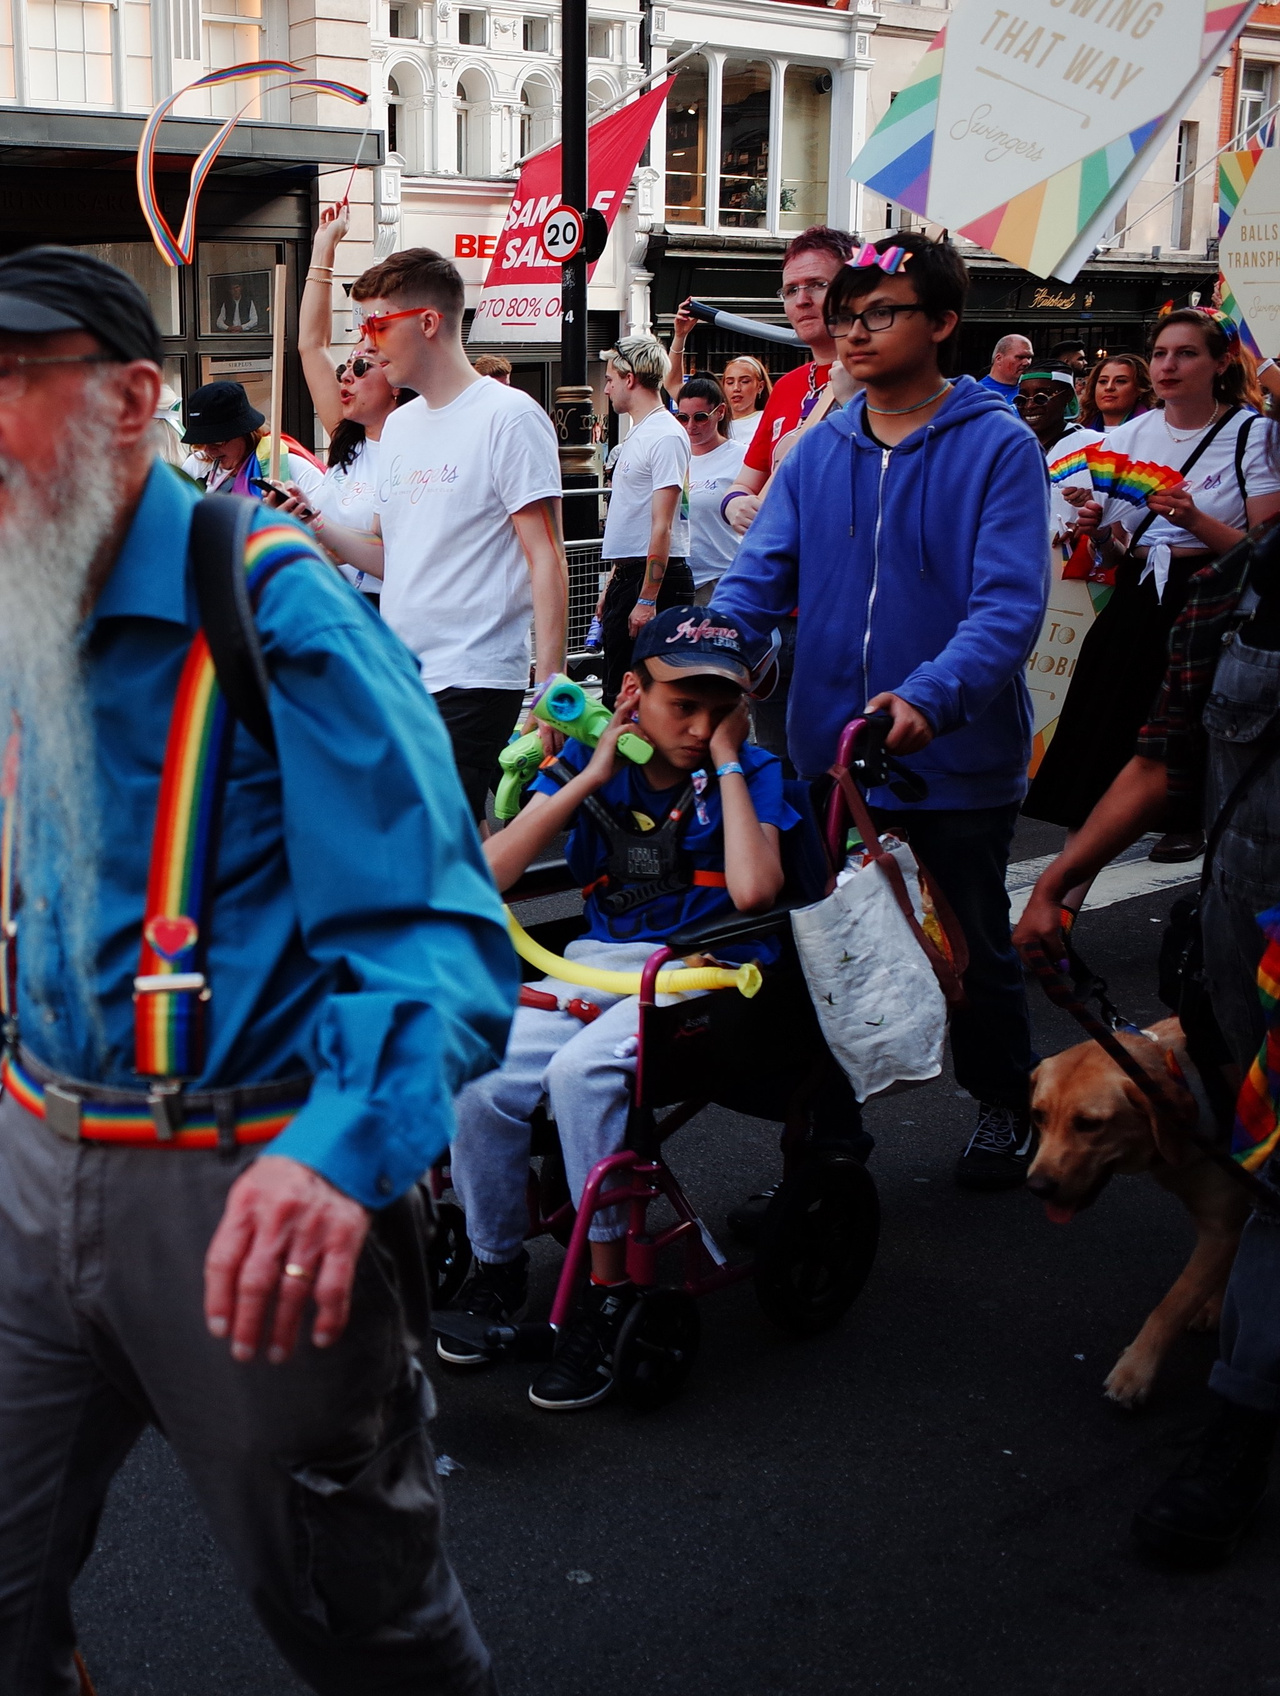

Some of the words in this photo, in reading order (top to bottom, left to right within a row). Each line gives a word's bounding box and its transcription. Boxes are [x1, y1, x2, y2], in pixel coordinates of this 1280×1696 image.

[979, 9, 1066, 69] THAT
[1062, 43, 1144, 101] WAY
[949, 103, 1045, 162] Swingers
[547, 221, 577, 246] 20
[1240, 224, 1279, 242] BALLS
[502, 236, 562, 270] SAL
[486, 298, 505, 318] TO
[506, 297, 543, 318] 80%
[665, 616, 738, 644] Inferno
[1049, 622, 1076, 645] TO
